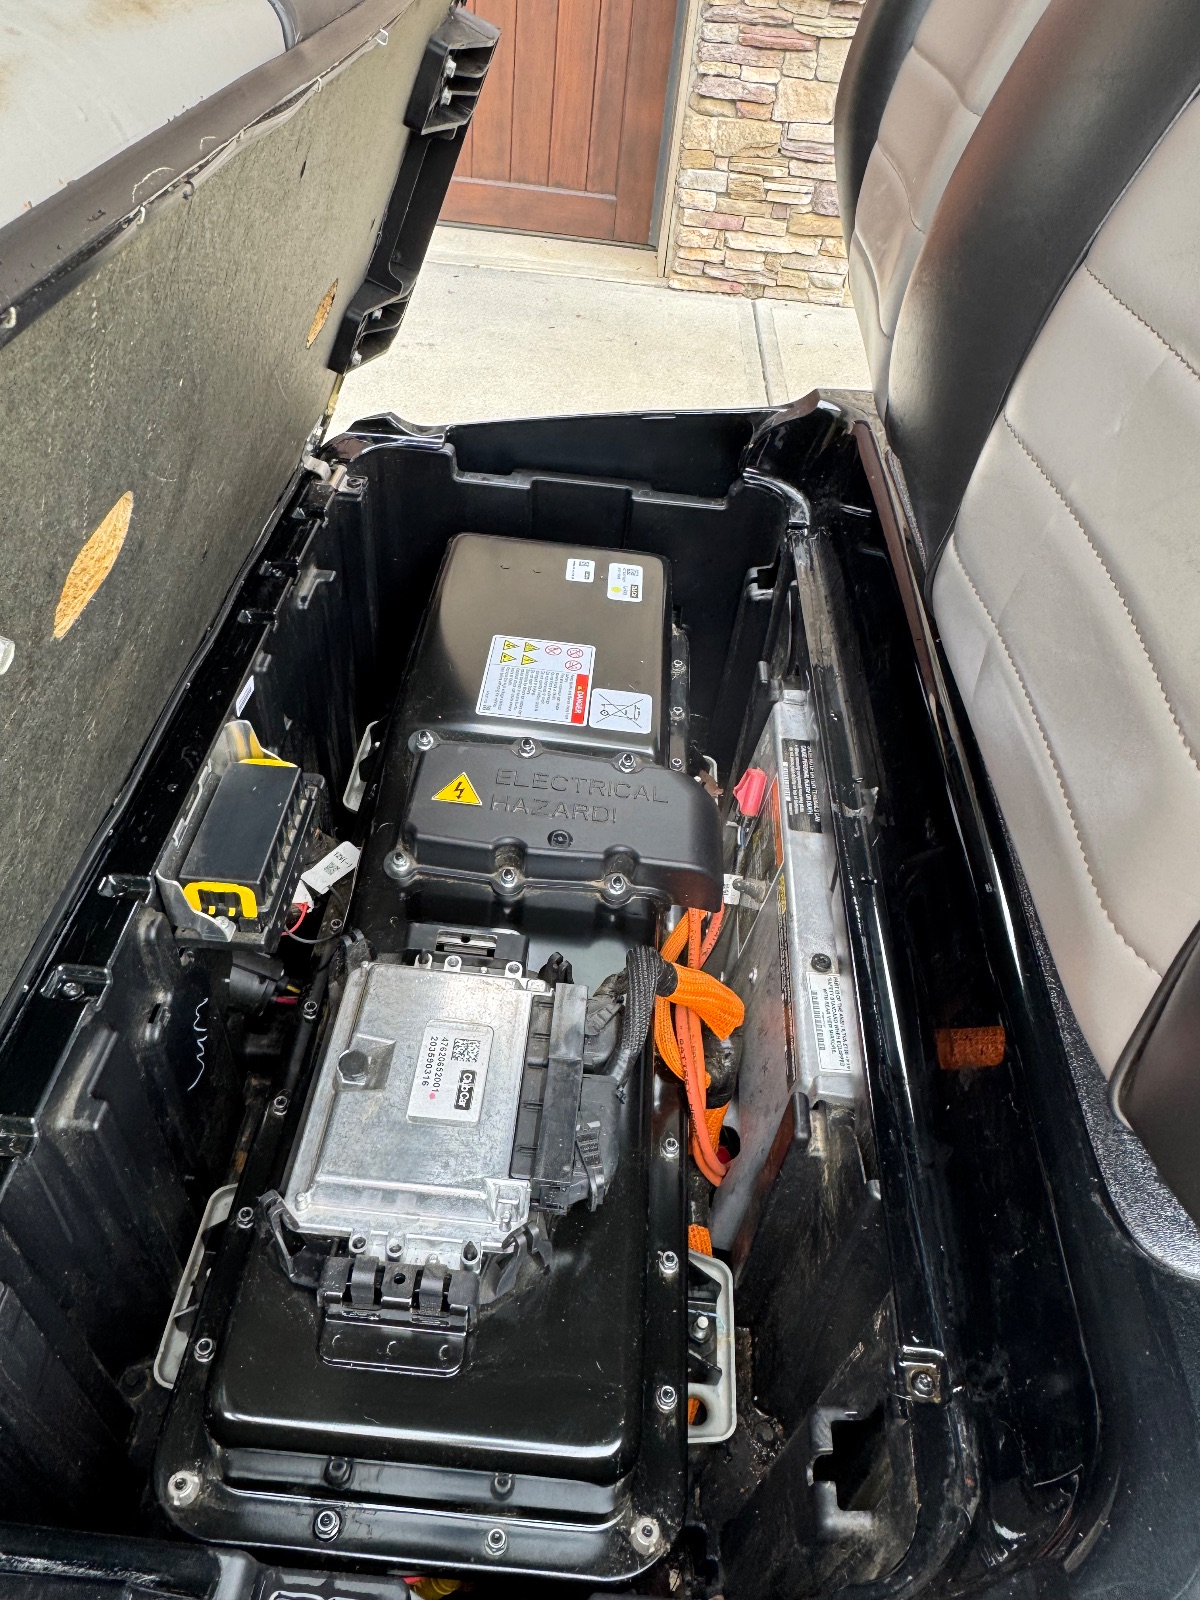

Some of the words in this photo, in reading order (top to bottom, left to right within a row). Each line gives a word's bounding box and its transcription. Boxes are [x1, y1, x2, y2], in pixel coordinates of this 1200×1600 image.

[495, 768, 669, 804] ELECTRICAL
[421, 1035, 439, 1087] 203590316
[432, 1036, 449, 1093] 47620652001
